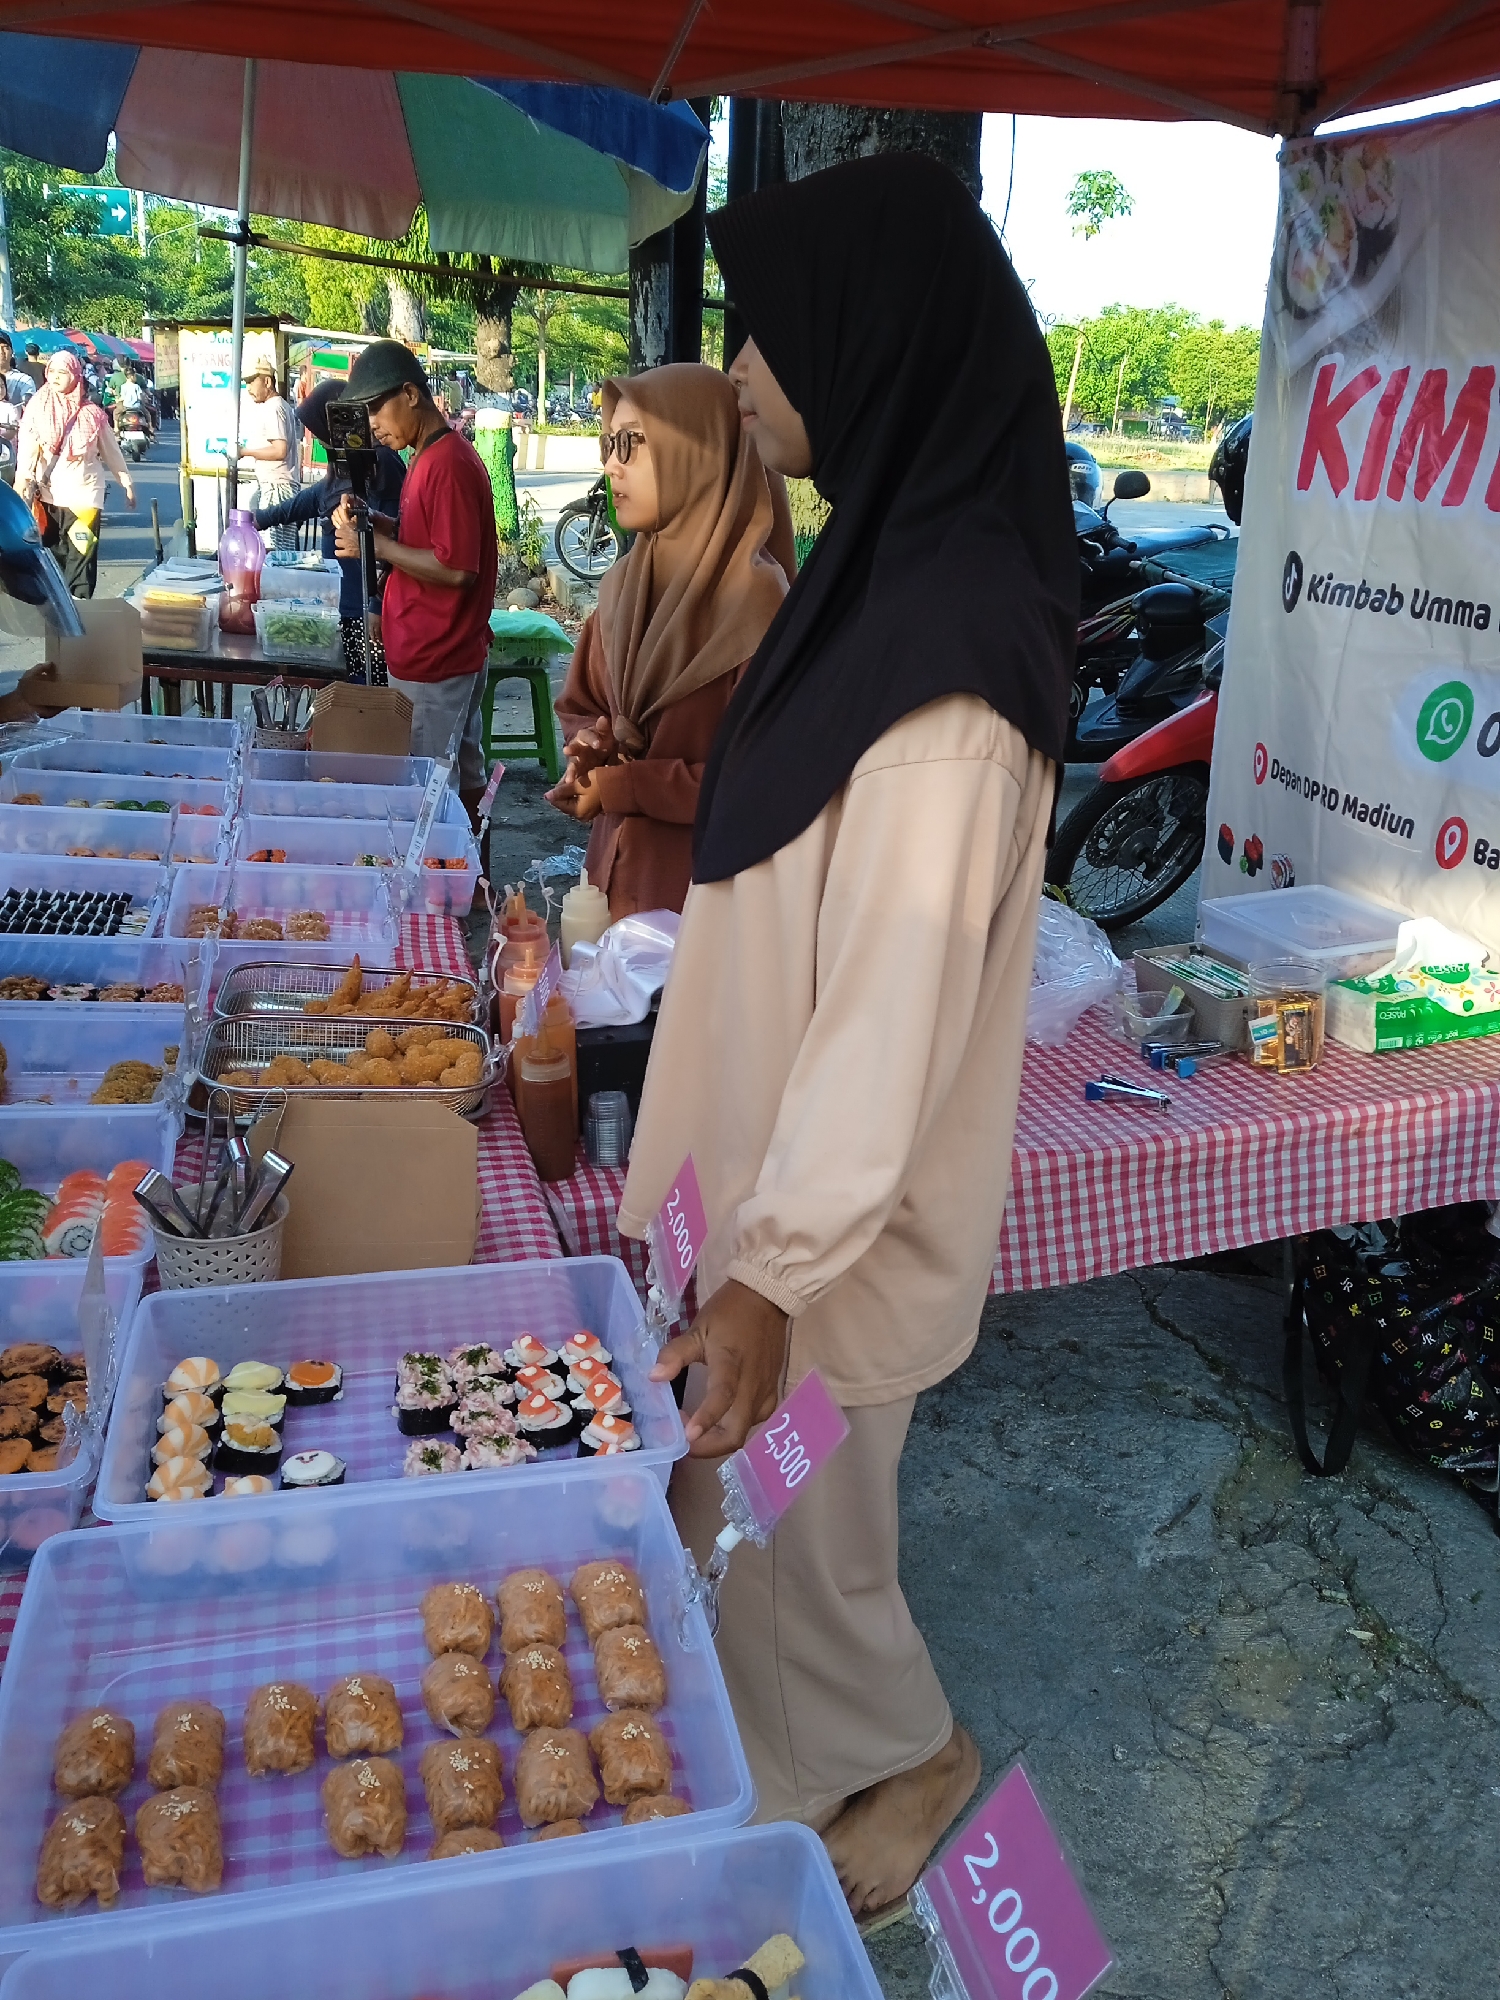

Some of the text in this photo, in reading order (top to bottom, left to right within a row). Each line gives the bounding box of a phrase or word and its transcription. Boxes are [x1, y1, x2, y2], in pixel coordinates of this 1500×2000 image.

[1297, 363, 1500, 512] KIM
[1307, 572, 1491, 631] Kimbab Umma
[1270, 758, 1415, 839] Depan DPRD Madiun
[664, 1188, 692, 1269] 2,000
[764, 1413, 810, 1488] 2,500
[963, 1831, 1059, 2000] 2,000
